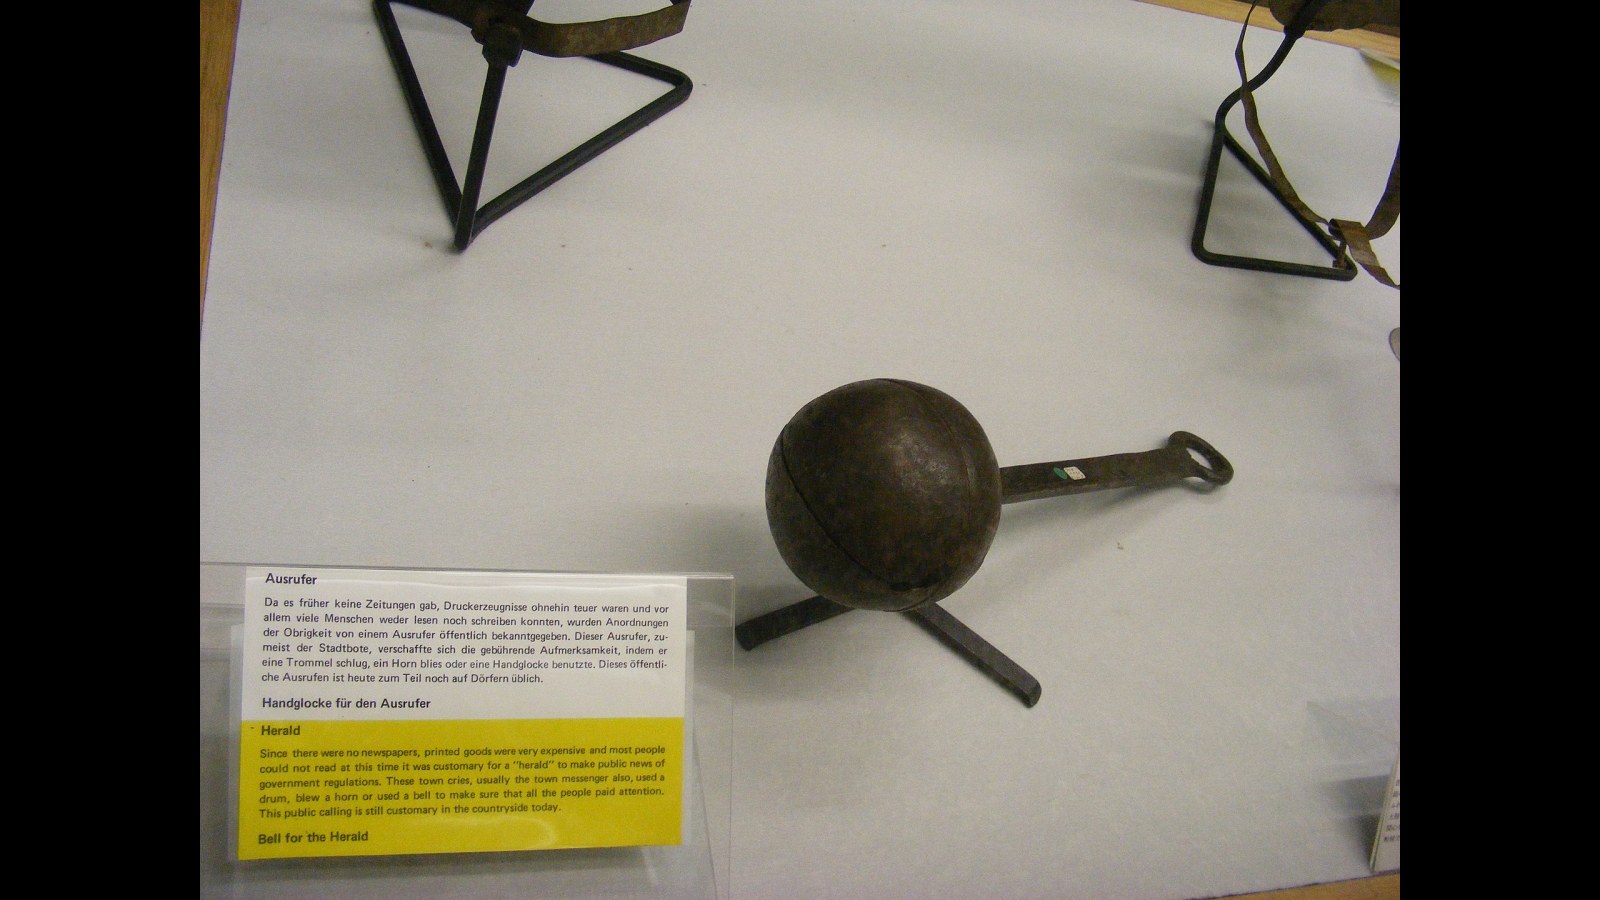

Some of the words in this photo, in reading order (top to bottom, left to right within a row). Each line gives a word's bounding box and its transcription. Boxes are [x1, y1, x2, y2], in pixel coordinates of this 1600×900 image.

[265, 572, 318, 585] Ausrufer
[264, 597, 279, 607] Da
[283, 599, 294, 608] es
[299, 597, 330, 608] früher
[334, 598, 362, 609] keine
[365, 599, 416, 612] Zeitungen
[419, 601, 440, 612] gab,
[443, 600, 528, 614] Druckerzeugnisse
[531, 602, 570, 612] ohnehin
[573, 604, 598, 613] teuer
[601, 605, 629, 613] waren
[632, 604, 651, 613] und
[654, 606, 670, 614] vor
[263, 612, 291, 622] allem
[296, 613, 319, 623] viele
[324, 613, 374, 624] Menschen
[379, 614, 409, 625] weder
[414, 615, 438, 625] lesen
[443, 616, 467, 626] noch
[471, 616, 517, 626] schreiben
[520, 616, 563, 628] konnten,
[566, 617, 602, 627] wurden
[605, 617, 669, 629] Anordnungen
[262, 627, 280, 637] der
[283, 627, 332, 640] Obrigkeit
[358, 631, 388, 639] einem
[392, 629, 436, 640] Ausrufer
[439, 630, 488, 640] öffentlich
[491, 631, 571, 643] bekanntgegeben.
[574, 631, 604, 641] Dieser
[607, 631, 651, 643] Ausrufer,
[654, 634, 669, 642] zu-
[262, 644, 291, 652] meist
[296, 642, 313, 653] der
[319, 642, 372, 655] Stadtbote,
[378, 644, 433, 654] verschaffte
[437, 644, 456, 654] sich
[461, 645, 476, 655] die
[480, 645, 536, 657] gebührende
[539, 645, 621, 656] Aufmerksamkeit,
[625, 646, 654, 655] indem
[261, 659, 283, 667] eine
[286, 657, 333, 668] Trommel
[336, 658, 371, 670] schlug,
[373, 660, 389, 668] ein
[391, 658, 417, 669] Horn
[420, 659, 443, 669] blies
[445, 659, 468, 669] oder
[469, 661, 490, 669] eine
[492, 659, 549, 671] Handglocke
[552, 660, 596, 669] benutzte.
[598, 659, 628, 669] Dieses
[629, 659, 667, 669] öffentli-
[261, 672, 280, 682] che
[282, 672, 329, 682] Ausrufen
[332, 674, 345, 683] ist
[347, 673, 376, 683] heute
[378, 675, 400, 683] zum
[402, 673, 422, 683] Teil
[424, 673, 449, 683] noch
[452, 673, 468, 683] auf
[471, 673, 509, 683] Dörfern
[511, 674, 544, 683] üblich.
[262, 697, 332, 711] Handglocke
[335, 697, 352, 709] für
[355, 697, 377, 709] den
[380, 697, 431, 709] Ausrufer
[261, 724, 301, 736] Herald
[259, 748, 288, 759] Since
[292, 748, 319, 758] there
[320, 750, 345, 758] were
[346, 750, 360, 758] no
[361, 749, 421, 760] newspapers,
[423, 747, 461, 759] printed
[463, 746, 492, 758] goods
[493, 748, 517, 756] were
[517, 748, 539, 757] very
[540, 745, 586, 757] expensive
[589, 745, 607, 755] and
[609, 746, 633, 755] most
[634, 745, 666, 756] people
[259, 763, 289, 774] could
[292, 764, 311, 773] not
[314, 763, 337, 773] read
[340, 764, 351, 772] at
[354, 762, 373, 772] this
[376, 762, 400, 772] time
[402, 761, 410, 771] it
[412, 763, 431, 771] was
[432, 762, 484, 773] customary
[487, 760, 502, 770] for
[504, 762, 510, 770] a
[557, 761, 568, 769] to
[569, 759, 596, 769] make
[597, 759, 628, 770] public
[629, 760, 653, 768] news
[655, 758, 666, 768] of
[259, 779, 321, 791] government
[324, 777, 382, 789] regulations.
[385, 776, 415, 786] These
[418, 777, 444, 786] town
[447, 775, 473, 786] cries,
[476, 774, 511, 786] usually
[514, 774, 530, 784] the
[533, 775, 558, 784] town
[561, 775, 609, 785] messenger
[612, 773, 634, 784] also,
[635, 772, 658, 782] used
[659, 774, 665, 782] a
[258, 794, 291, 805] drum,
[295, 793, 321, 803] blew
[324, 794, 331, 802] a
[334, 792, 359, 802] horn
[362, 793, 374, 801] or
[377, 791, 400, 801] used
[403, 793, 410, 801] a
[413, 790, 431, 800] bell
[435, 791, 446, 800] to
[449, 789, 476, 800] make
[479, 791, 500, 799] sure
[503, 789, 523, 799] that
[526, 788, 538, 798] all
[541, 788, 557, 798] the
[560, 787, 592, 799] people
[595, 786, 616, 798] paid
[618, 786, 665, 796] attention.
[258, 808, 282, 819] This
[284, 807, 317, 820] public
[318, 806, 353, 818] calling
[354, 806, 363, 816] is
[365, 805, 384, 816] still
[386, 806, 439, 817] customary
[441, 804, 451, 814] in
[453, 804, 470, 814] the
[471, 802, 529, 814] countryside
[531, 802, 562, 813] today.
[258, 832, 282, 845] Bell
[284, 832, 304, 844] for
[306, 831, 326, 843] the
[329, 830, 369, 842] Herald
